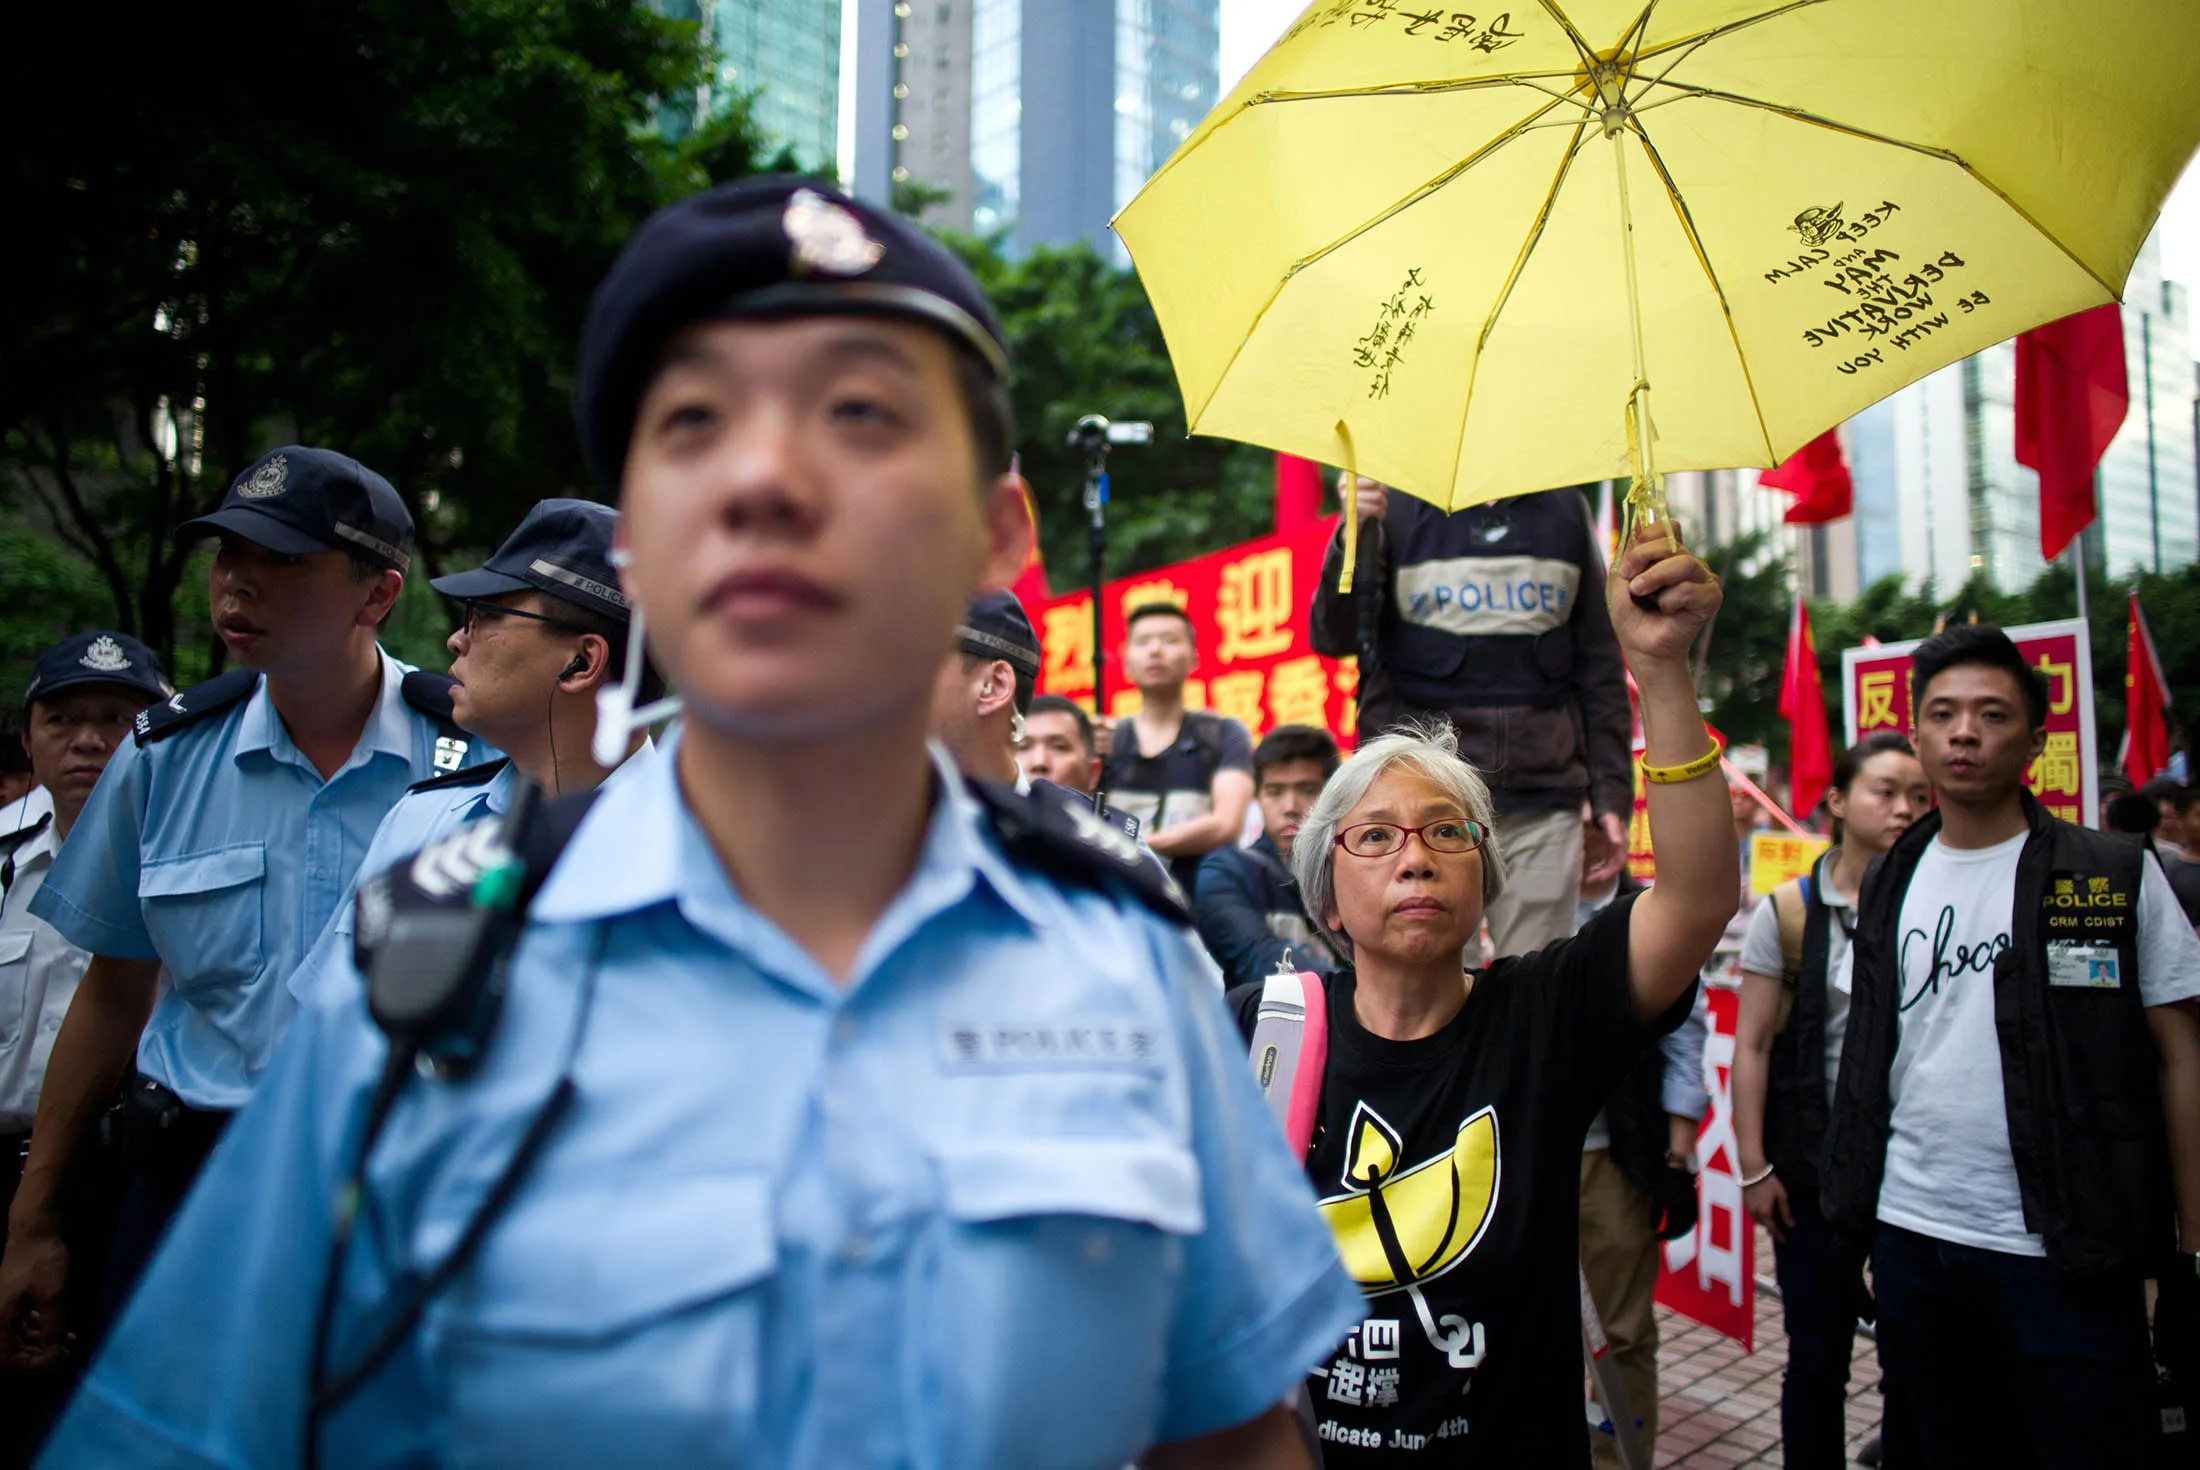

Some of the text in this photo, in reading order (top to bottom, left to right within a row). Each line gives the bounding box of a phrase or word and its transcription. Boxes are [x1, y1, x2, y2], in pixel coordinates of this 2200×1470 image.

[585, 581, 626, 606] POLICE
[1435, 581, 1557, 613] POLICE
[2042, 893, 2128, 908] POLICE
[1389, 1429, 1434, 1450] Jun
[1436, 1416, 1470, 1438] 4th
